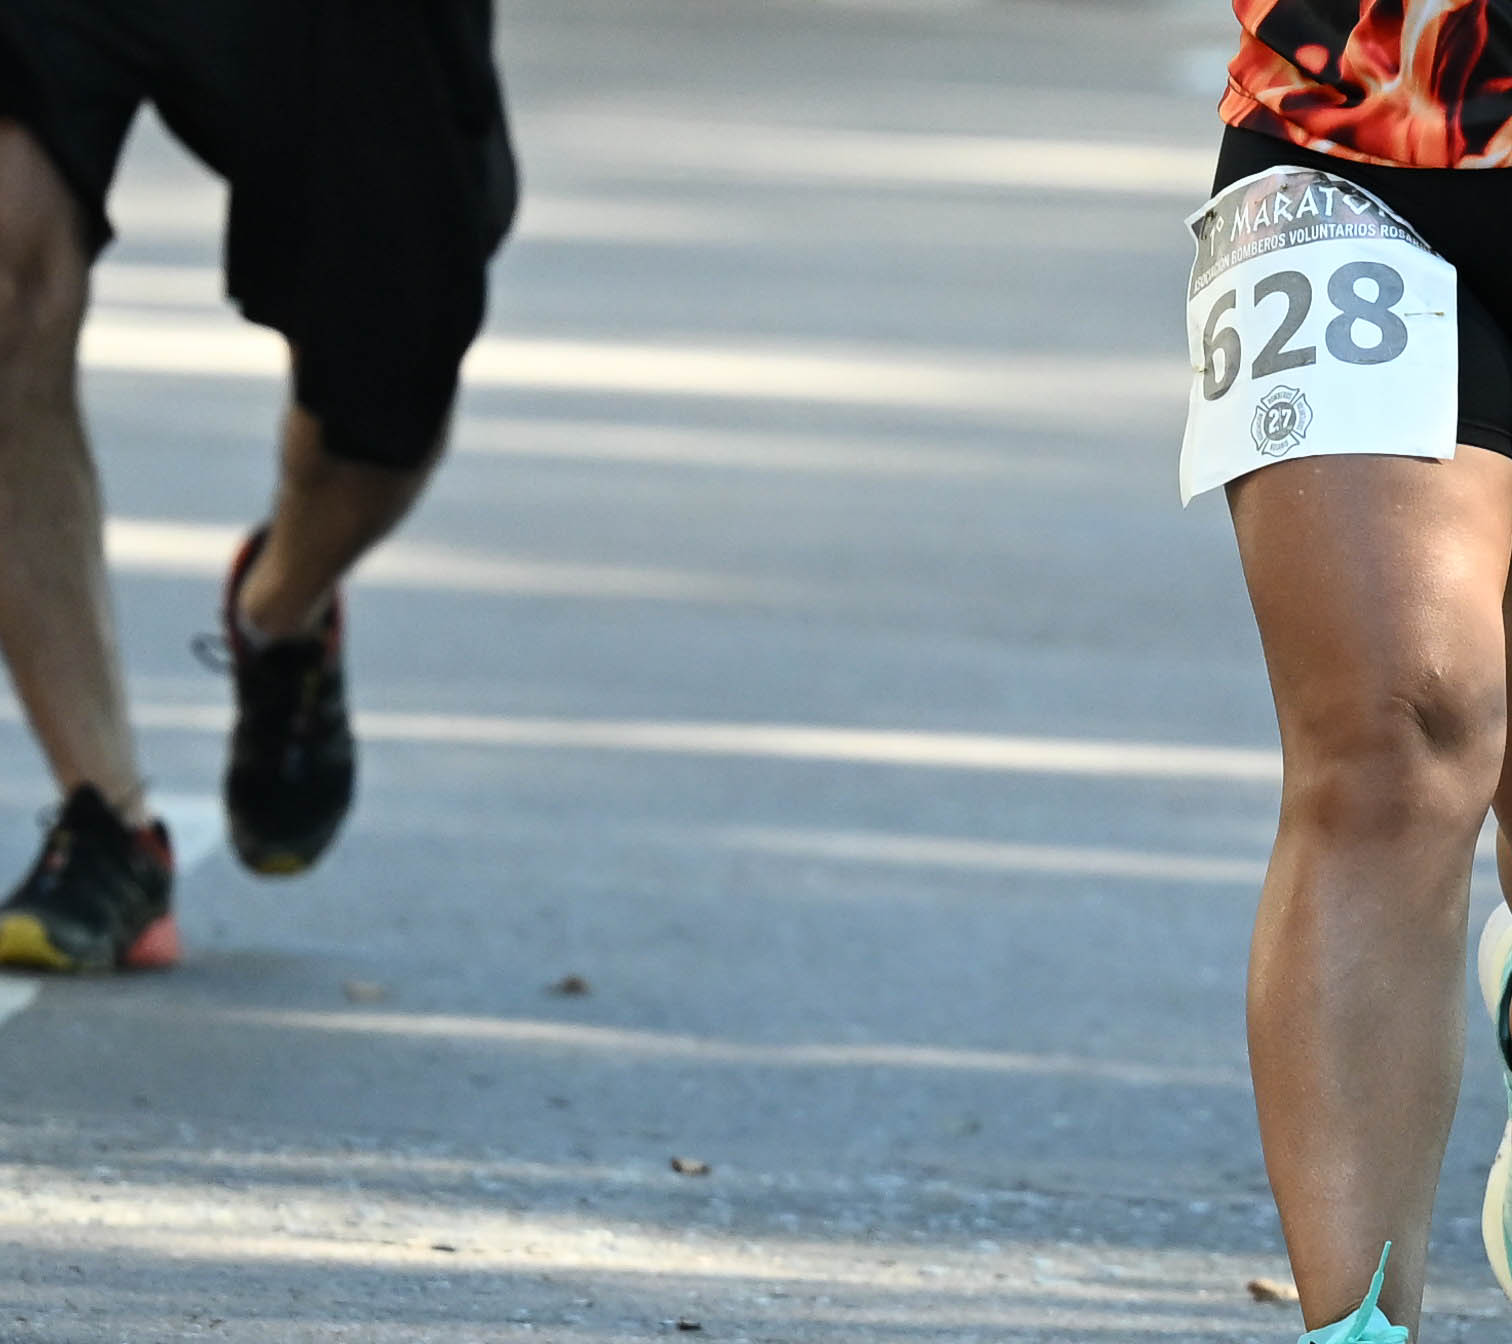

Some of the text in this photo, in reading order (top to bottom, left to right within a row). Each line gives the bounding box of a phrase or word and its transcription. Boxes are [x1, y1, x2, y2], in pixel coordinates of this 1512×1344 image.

[1231, 232, 1287, 266] BOMBEROS
[1288, 223, 1377, 247] VOLUNTARIOS
[1202, 261, 1408, 402] 628
[1268, 408, 1293, 435] 27
